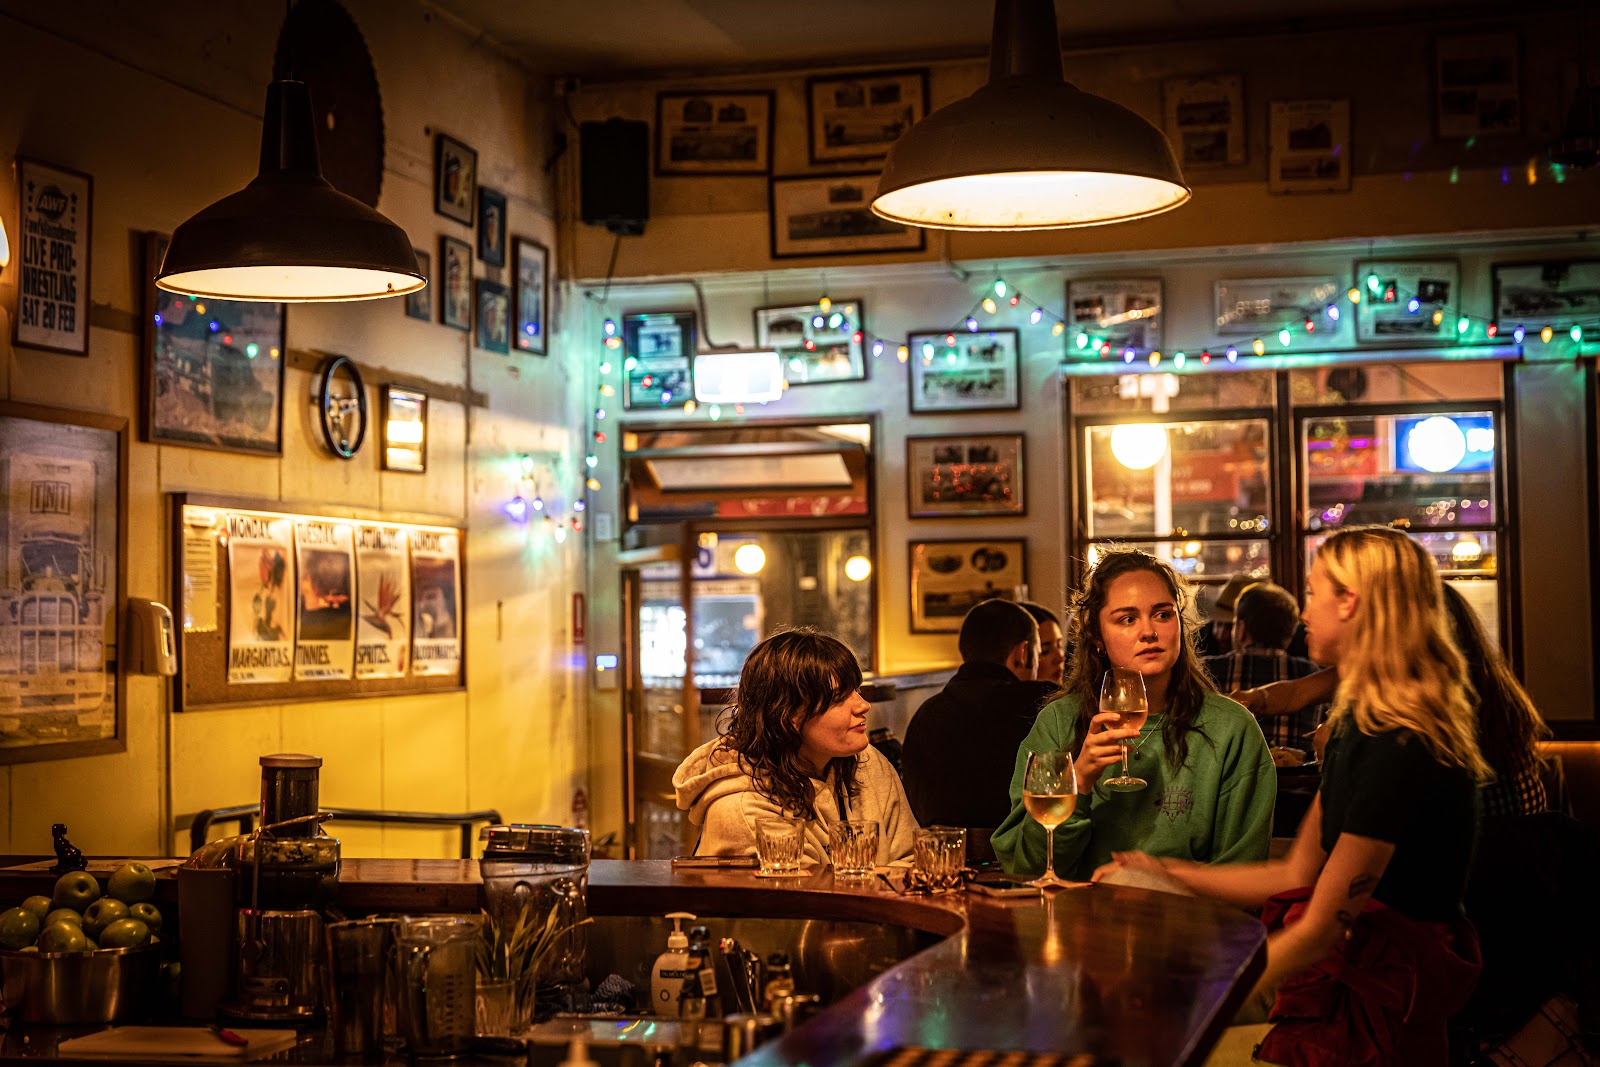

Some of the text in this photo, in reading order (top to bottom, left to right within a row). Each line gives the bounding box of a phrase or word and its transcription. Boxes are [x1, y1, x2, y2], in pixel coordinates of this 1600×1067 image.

[23, 234, 77, 272] LIVE PRO-
[23, 266, 76, 304] WRESTLING
[22, 298, 75, 333] SAT 20 FEB
[34, 483, 67, 510] TNT
